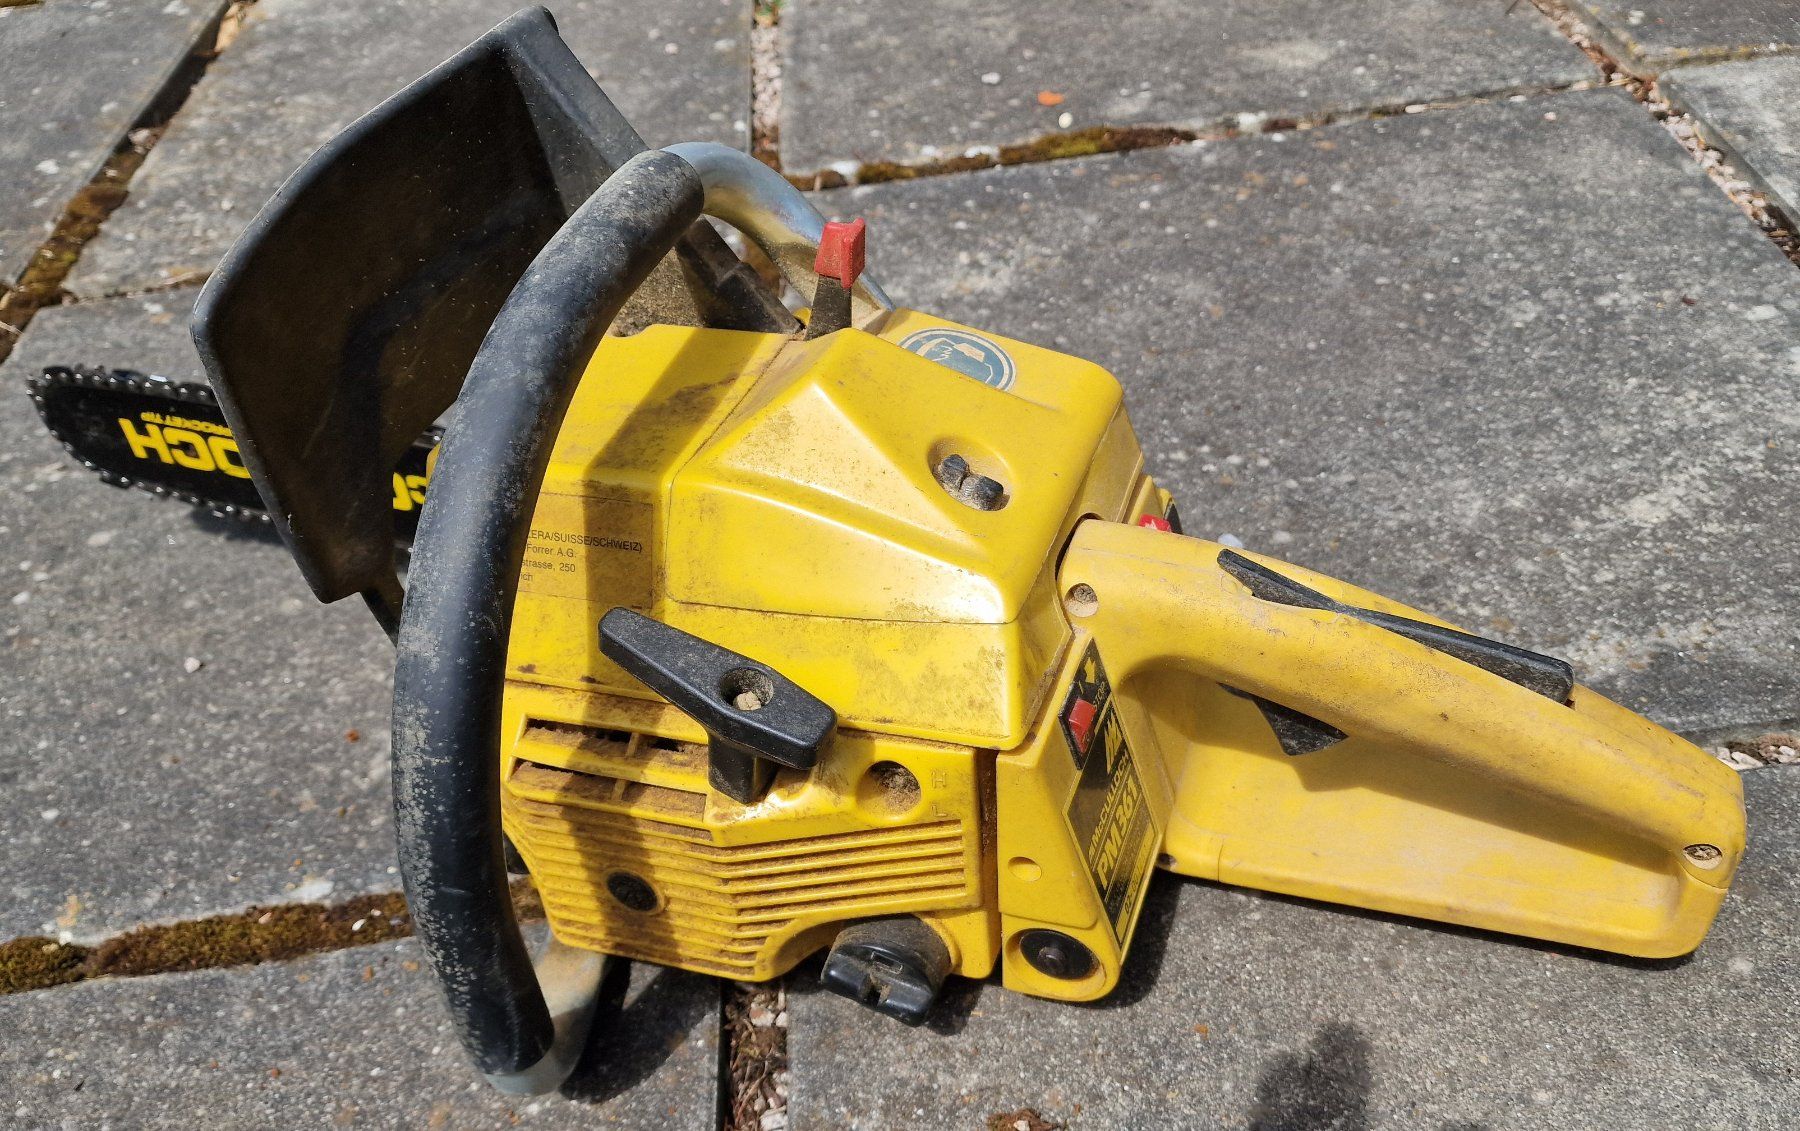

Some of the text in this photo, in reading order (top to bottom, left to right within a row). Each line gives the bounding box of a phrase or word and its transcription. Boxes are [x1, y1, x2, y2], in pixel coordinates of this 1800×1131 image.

[526, 543, 577, 558] Forrer A.G.
[559, 561, 576, 573] 250
[1090, 749, 1130, 857] McCULLOCH
[1097, 774, 1138, 890] PM361
